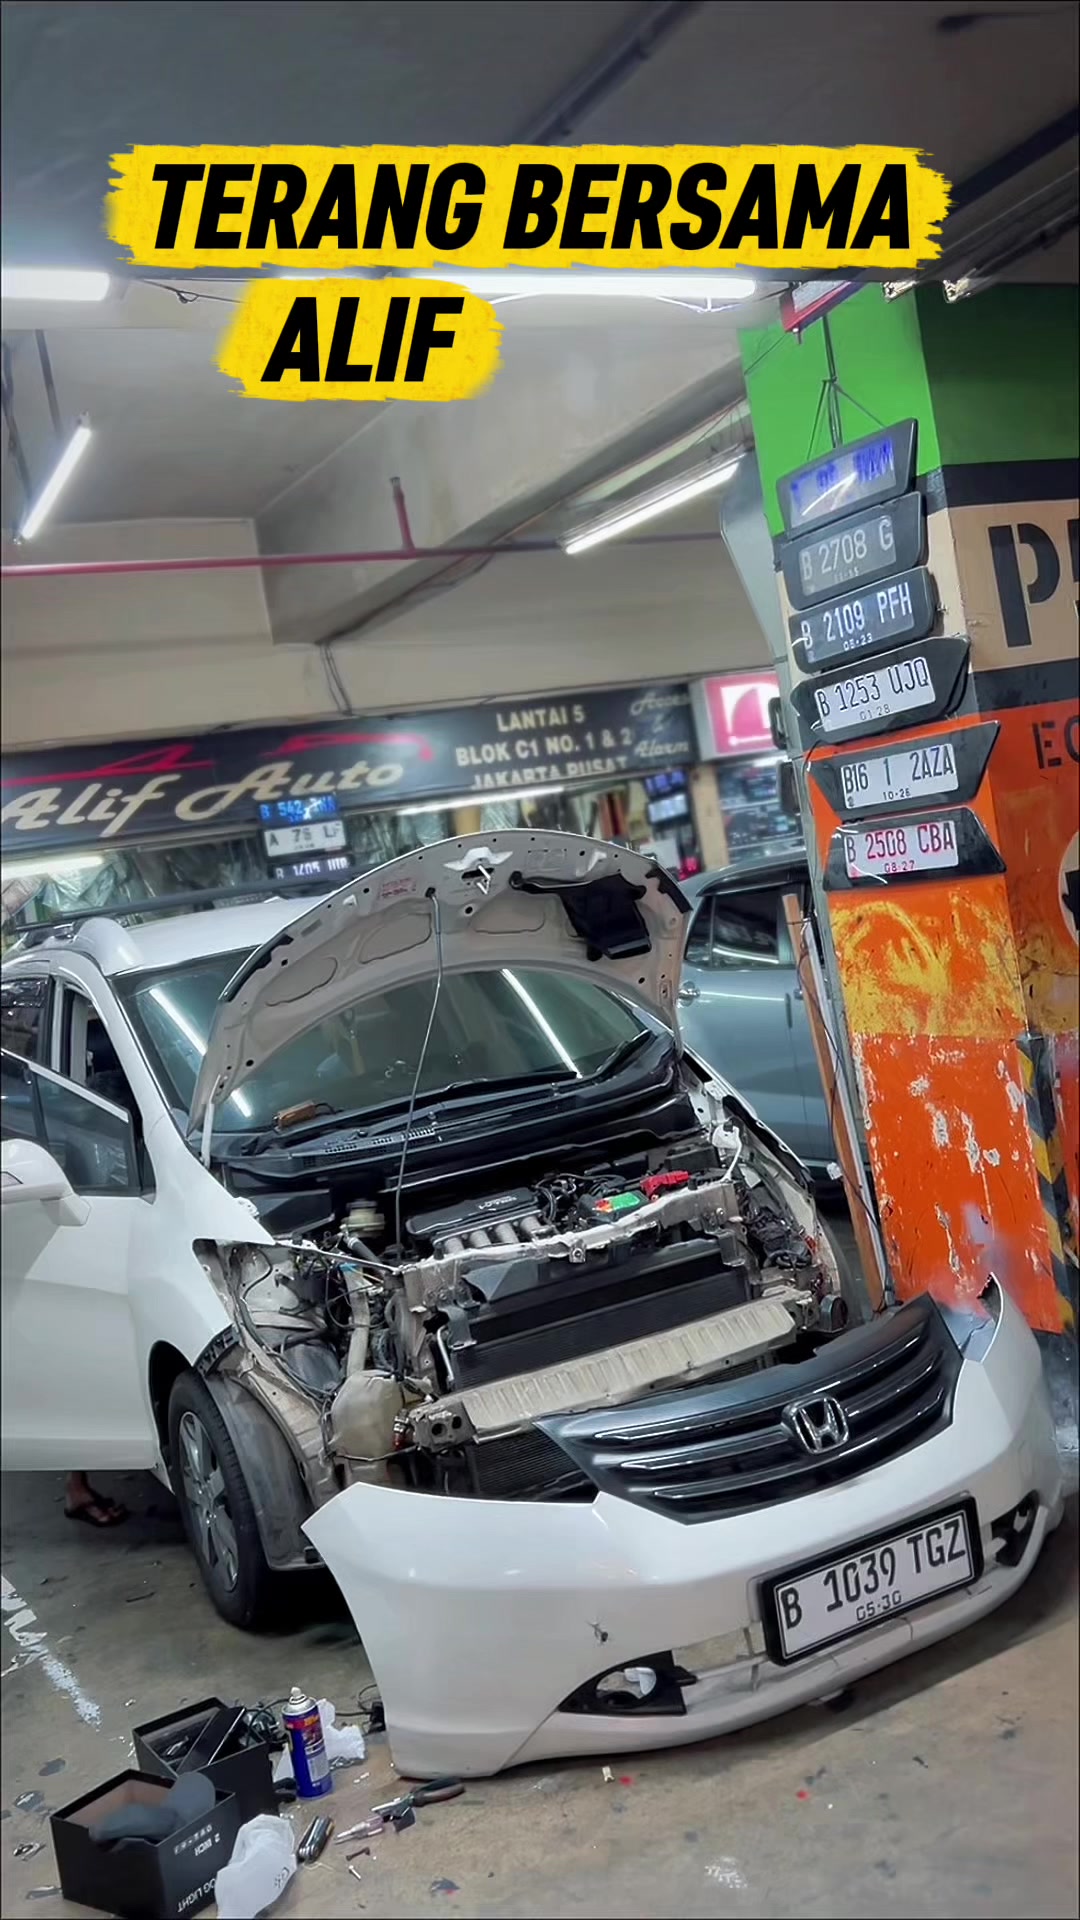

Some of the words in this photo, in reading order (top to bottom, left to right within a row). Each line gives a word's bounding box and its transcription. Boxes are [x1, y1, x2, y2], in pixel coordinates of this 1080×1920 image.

[801, 551, 813, 580] B
[818, 529, 867, 573] 2708
[879, 518, 893, 550] G
[801, 621, 813, 650] B
[823, 600, 865, 642] 2109
[876, 582, 912, 623] PFH
[817, 690, 830, 717] B
[834, 674, 880, 711] 1253
[887, 658, 929, 694] UJQ
[496, 708, 569, 732] LANTAI
[573, 705, 585, 723] 5
[456, 740, 511, 766] BLOK
[515, 738, 539, 759] C1
[545, 733, 580, 755] NO.
[585, 731, 595, 749] 1
[602, 729, 615, 747] &
[620, 728, 633, 745] 2
[472, 763, 562, 790] JAKARTA
[567, 756, 628, 778] PUSAT
[844, 763, 869, 794] B16
[883, 758, 891, 785] 1
[1, 773, 182, 837] Alif
[175, 761, 403, 820] Auto
[269, 832, 279, 847] A
[845, 836, 857, 863] B
[865, 829, 907, 859] 2508
[917, 822, 954, 853] CBA
[780, 1587, 802, 1629] B
[823, 1547, 896, 1612] 1039
[907, 1520, 965, 1574] TGZ
[177, 1887, 203, 1913] LIGHT
